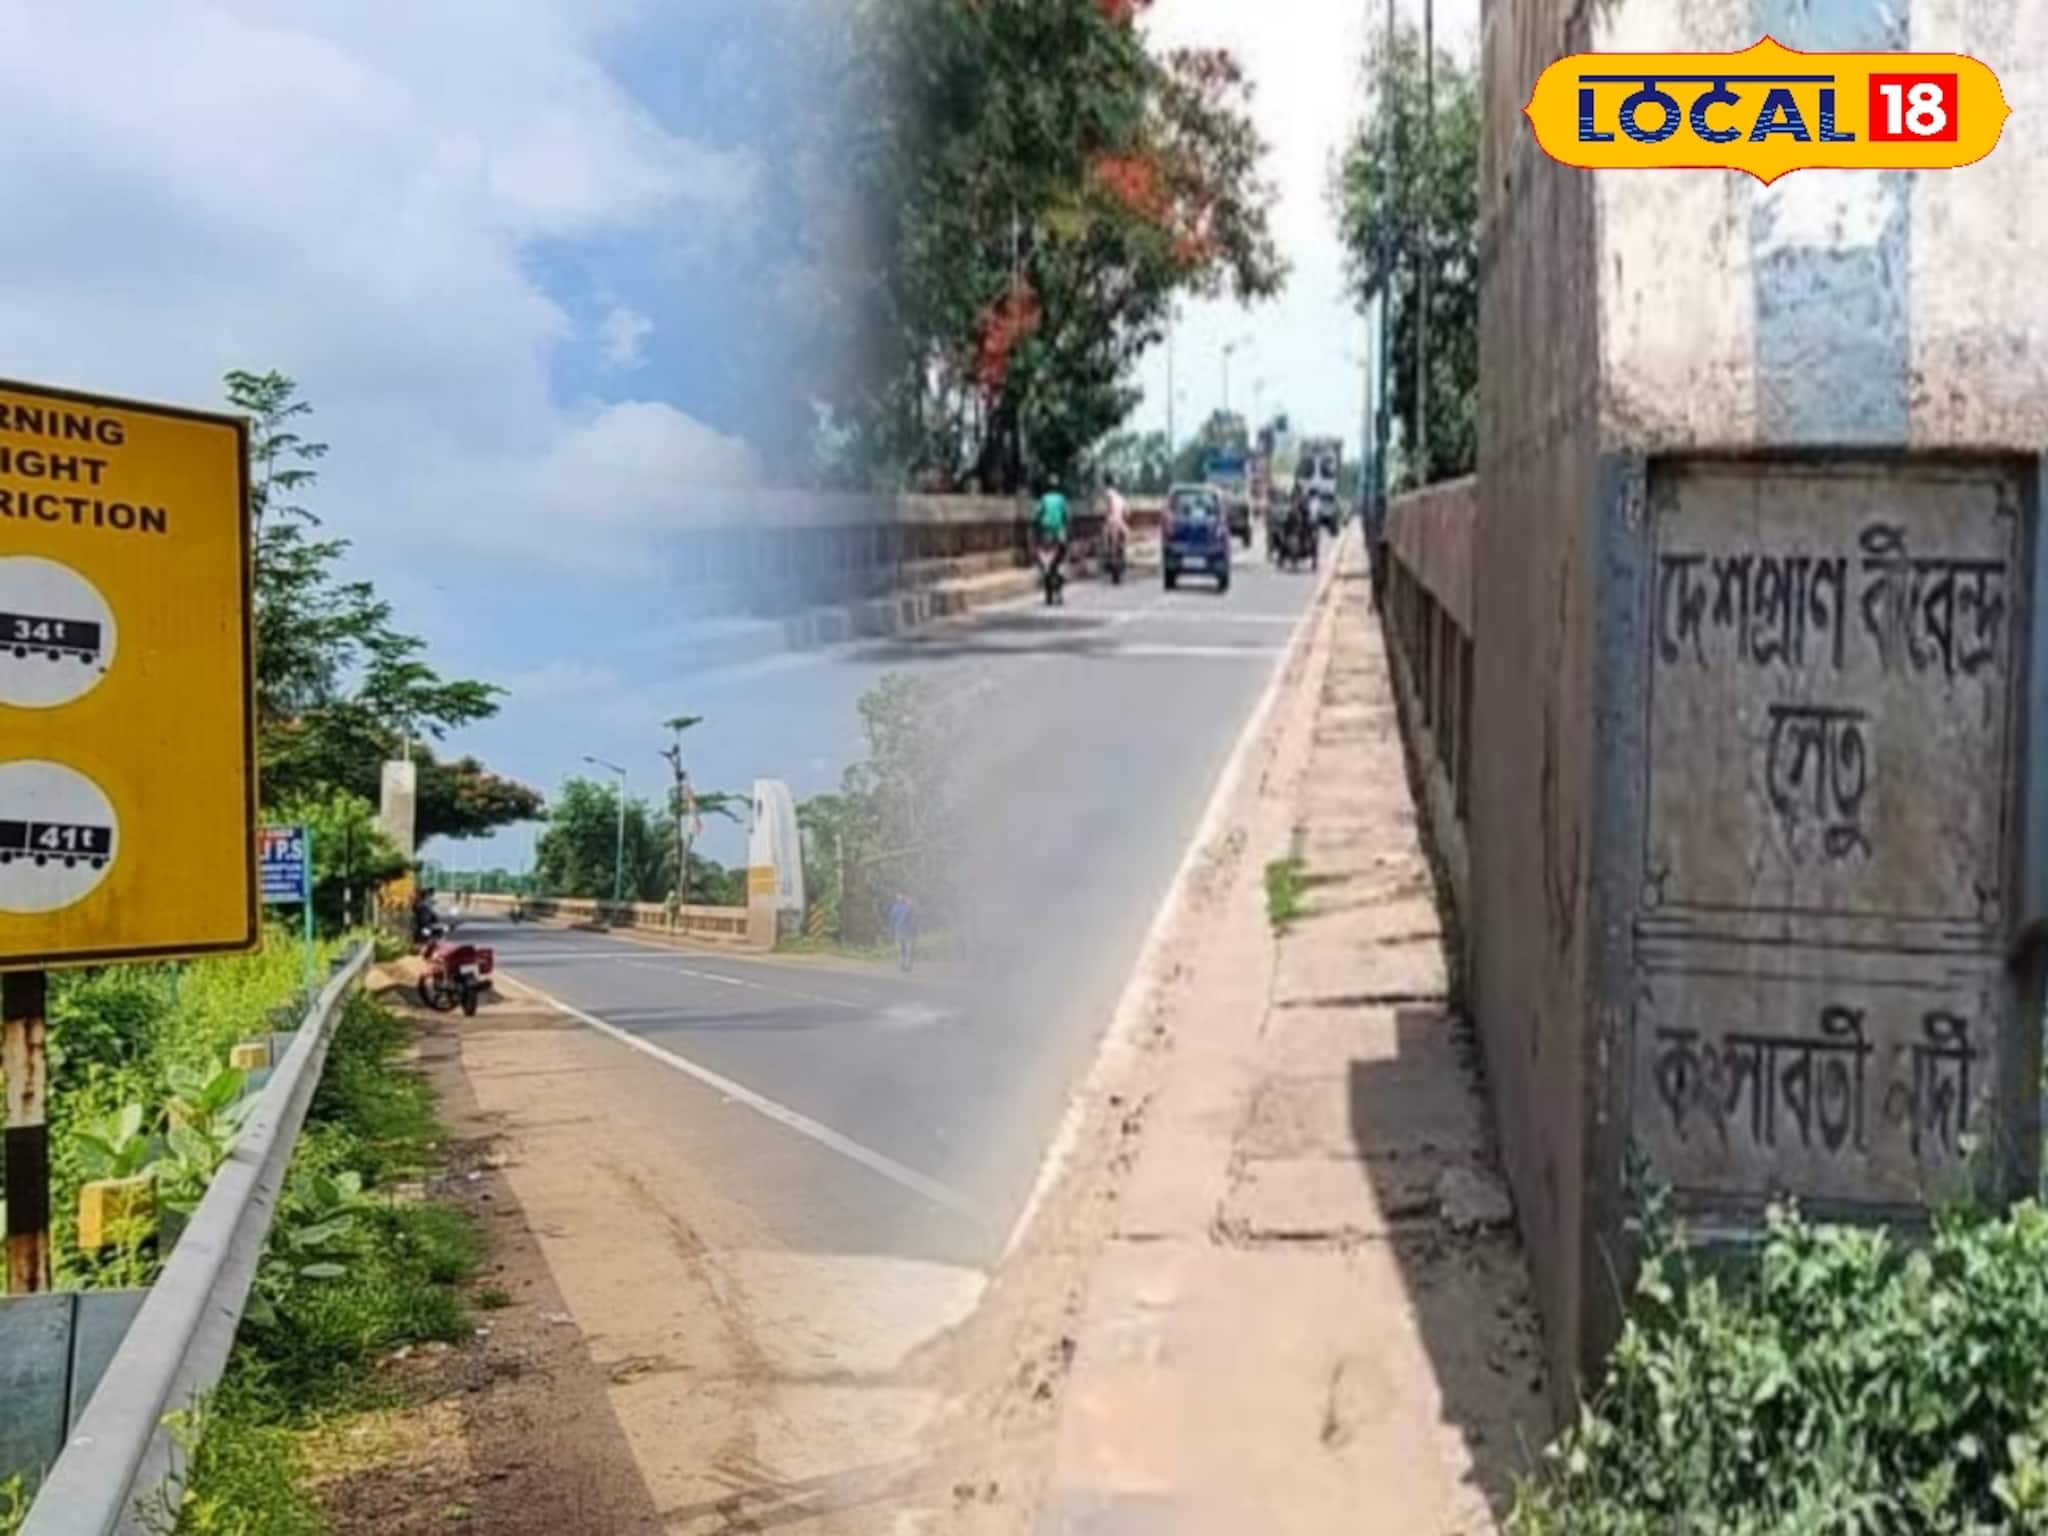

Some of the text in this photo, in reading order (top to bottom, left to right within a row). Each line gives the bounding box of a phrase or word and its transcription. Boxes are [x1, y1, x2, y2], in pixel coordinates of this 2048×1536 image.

[14, 619, 64, 640] 34t
[1766, 706, 1872, 860] সেতু
[39, 826, 94, 849] 41t
